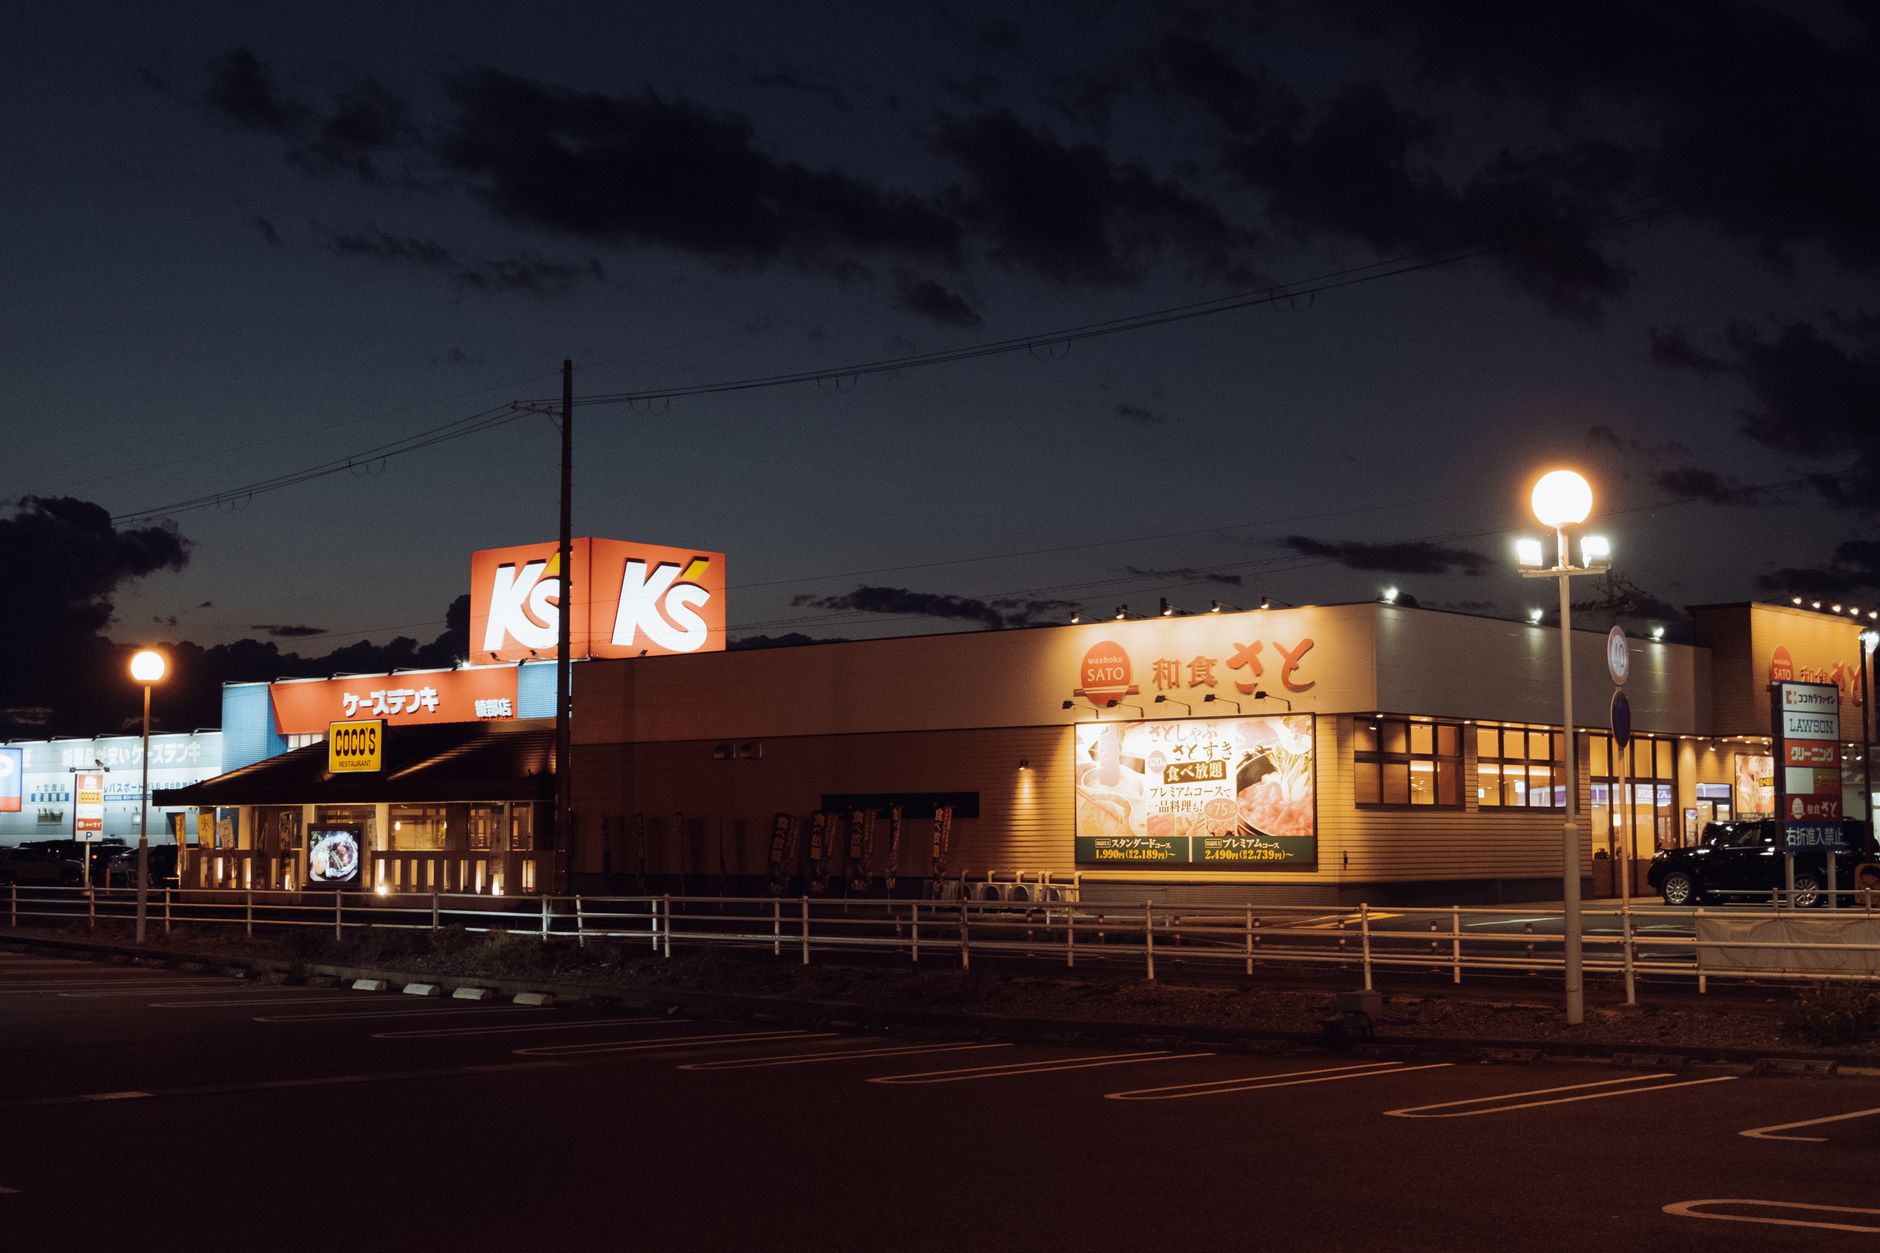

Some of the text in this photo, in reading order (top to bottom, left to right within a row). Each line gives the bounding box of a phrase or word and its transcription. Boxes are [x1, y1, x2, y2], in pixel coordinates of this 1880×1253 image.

[1088, 656, 1123, 665] washoku
[1613, 643, 1625, 669] 40
[1151, 638, 1316, 695] 和食さと
[1087, 667, 1124, 681] SATO
[1773, 667, 1791, 681] SATO
[1789, 718, 1834, 734] LAWSON
[335, 728, 376, 757] COCO'S
[1790, 746, 1834, 761] クリーニング
[338, 760, 371, 768] RESTAURANT
[1166, 762, 1223, 783] 食べ放題
[1150, 786, 1231, 799] プレミアムコースで
[86, 832, 92, 840] P
[1786, 827, 1843, 846] 右折進入禁止
[1111, 838, 1171, 850] スタンダードコース
[1222, 837, 1280, 850] プレミアムコース
